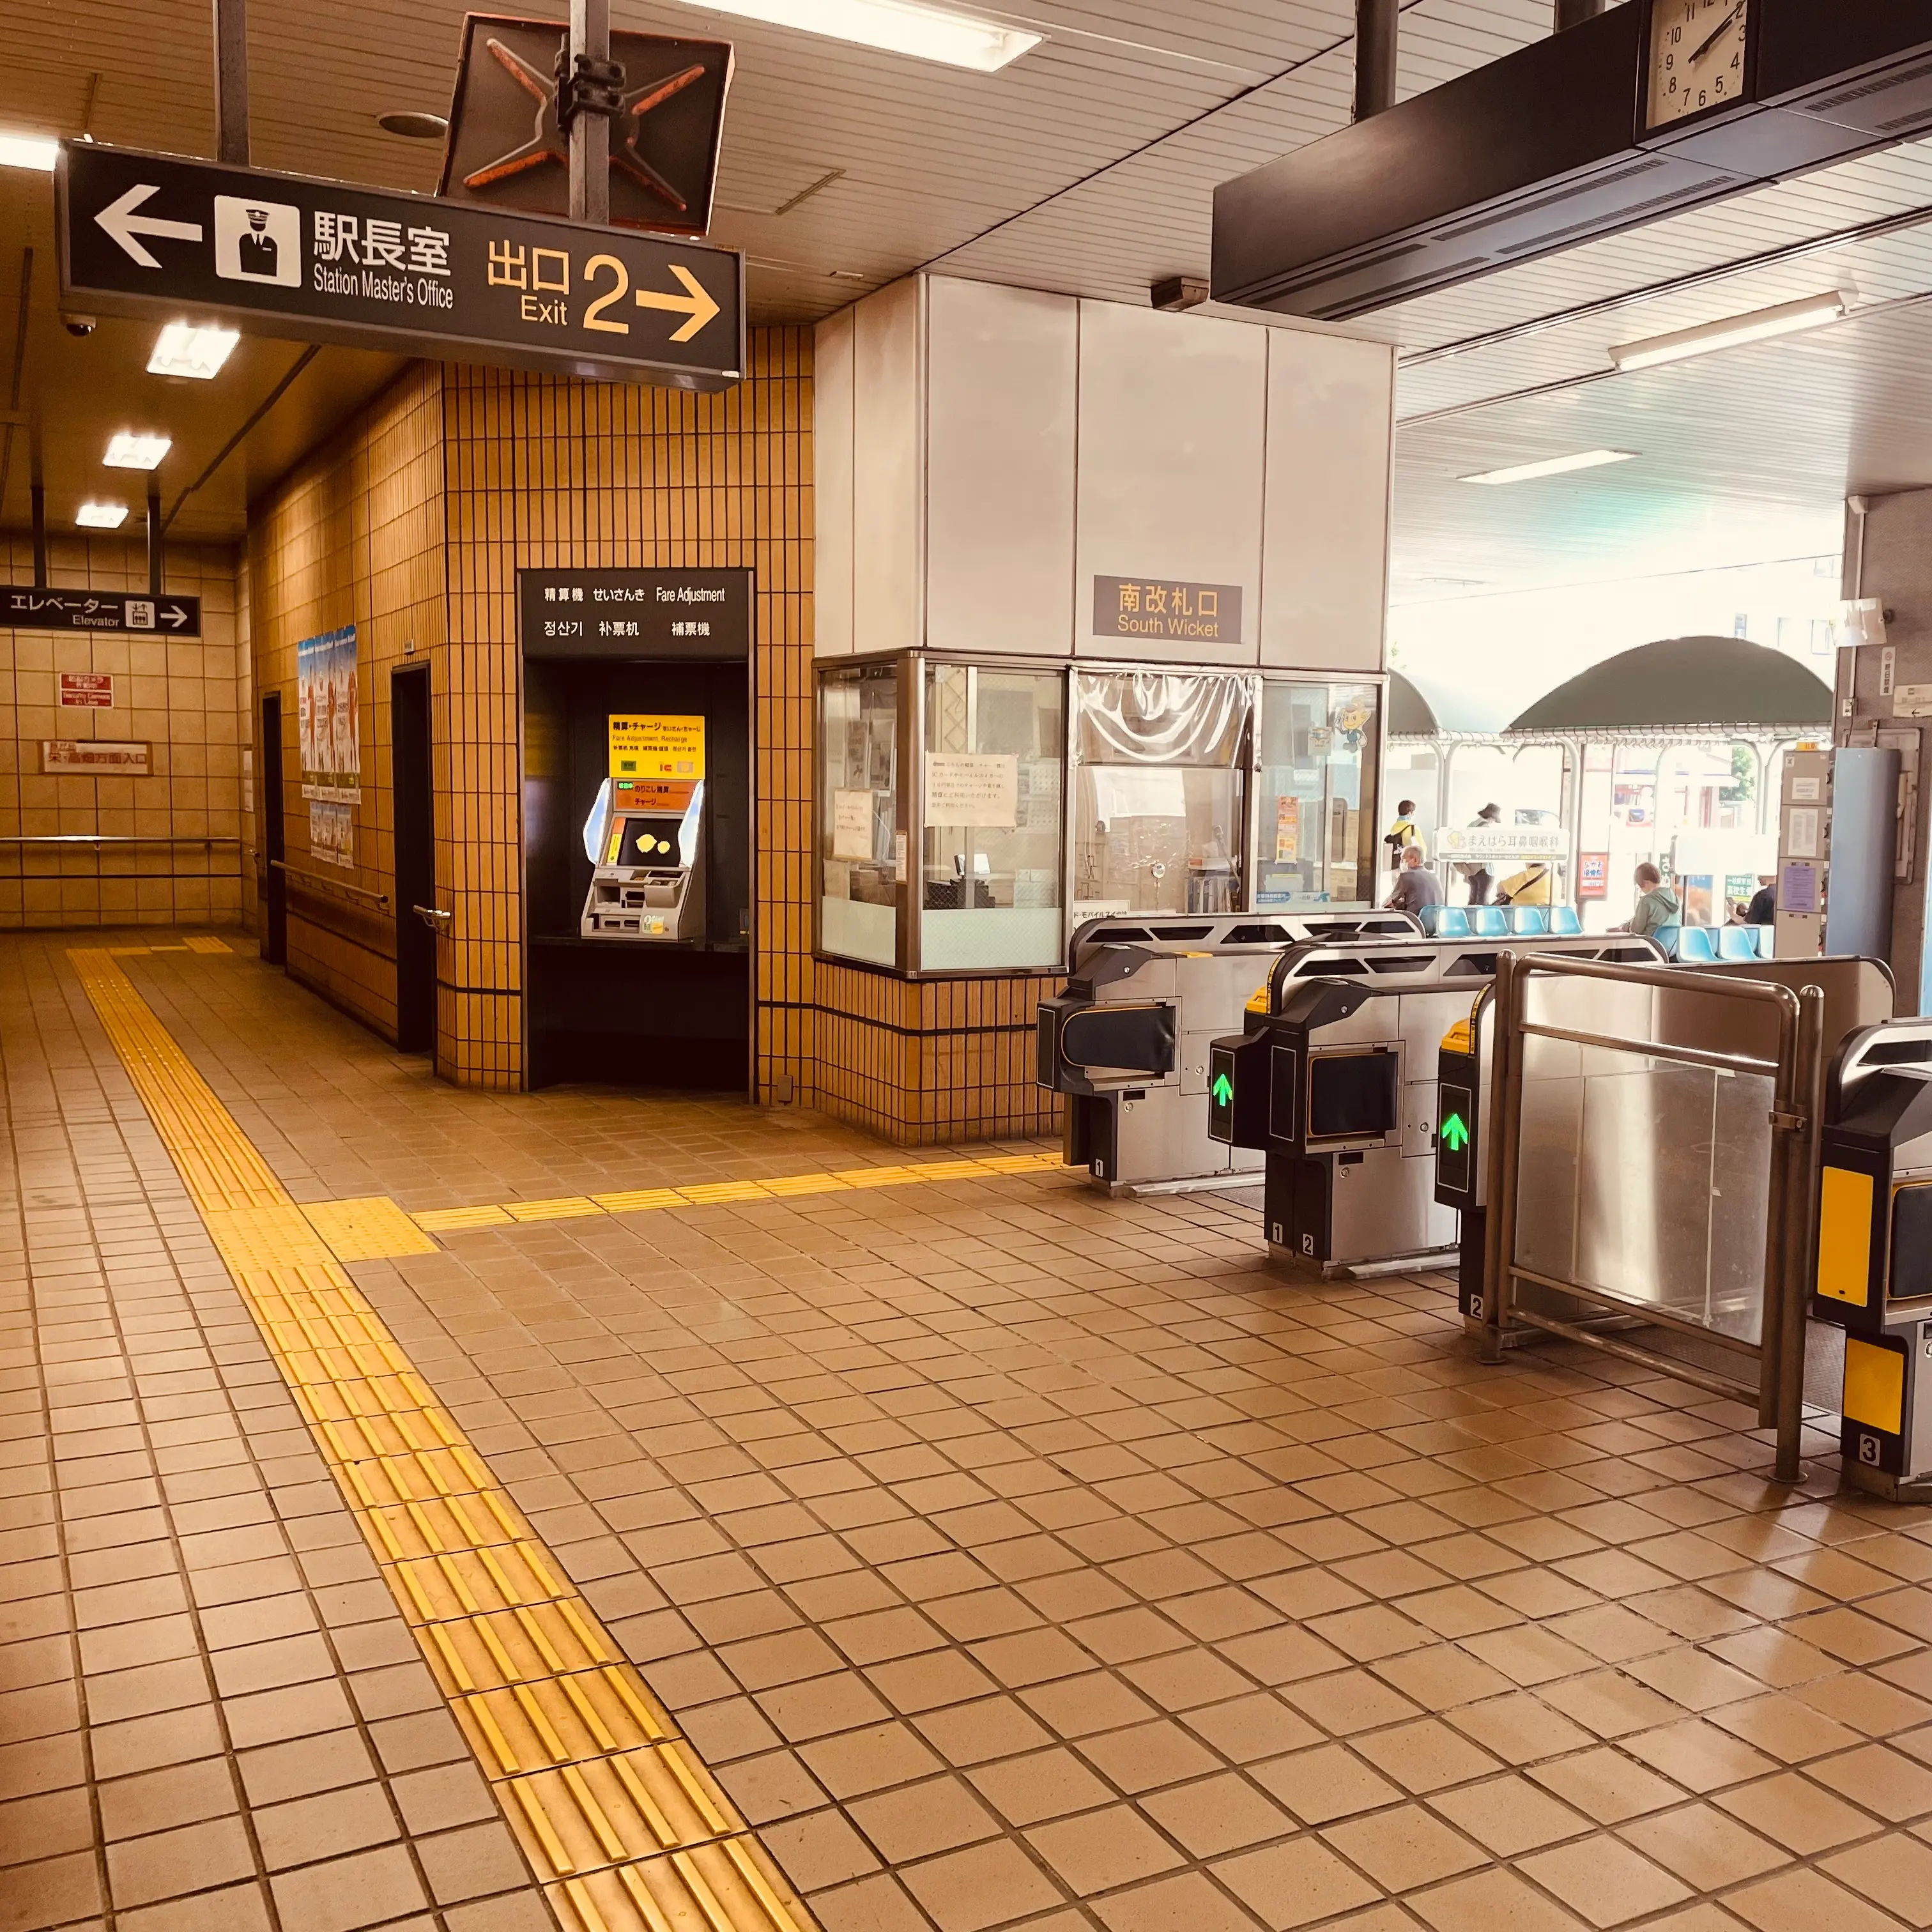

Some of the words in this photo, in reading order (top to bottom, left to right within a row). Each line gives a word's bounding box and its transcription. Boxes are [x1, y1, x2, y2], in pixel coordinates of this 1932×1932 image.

[1687, 3, 1695, 22] 11
[1671, 26, 1682, 45] 10
[1738, 24, 1746, 42] 3
[1666, 54, 1674, 70] 9
[1730, 52, 1740, 70] 4
[1669, 77, 1676, 93] 8
[1715, 75, 1724, 93] 5
[1683, 88, 1691, 106] 7
[1698, 90, 1706, 106] 6
[313, 210, 451, 277] 駅長室
[313, 263, 358, 296] Station
[362, 271, 414, 305] Master's
[417, 276, 454, 310] Office
[487, 240, 570, 295] 出口
[583, 255, 629, 334] 2
[521, 295, 567, 326] Exit
[11, 595, 118, 613] エレベーター
[544, 587, 583, 602] 精算機
[593, 588, 645, 602] せいさんき
[656, 586, 675, 602] Fare
[677, 586, 725, 605] Adjustment
[1119, 583, 1219, 618] 南改札口
[73, 614, 119, 627] Elevator
[544, 620, 583, 636] 정산기
[599, 620, 639, 636] 补票机
[671, 621, 710, 636] 補票機
[1118, 615, 1163, 634] South
[1168, 618, 1219, 638] Wicket
[613, 721, 661, 731] 精算・チャージ
[1469, 835, 1559, 848] まえはら耳鼻咽喉科
[1096, 1161, 1103, 1176] 1
[1274, 1225, 1281, 1241] 1
[1303, 1236, 1312, 1254] 2
[1471, 1297, 1482, 1317] 2
[1862, 1438, 1876, 1462] 3
